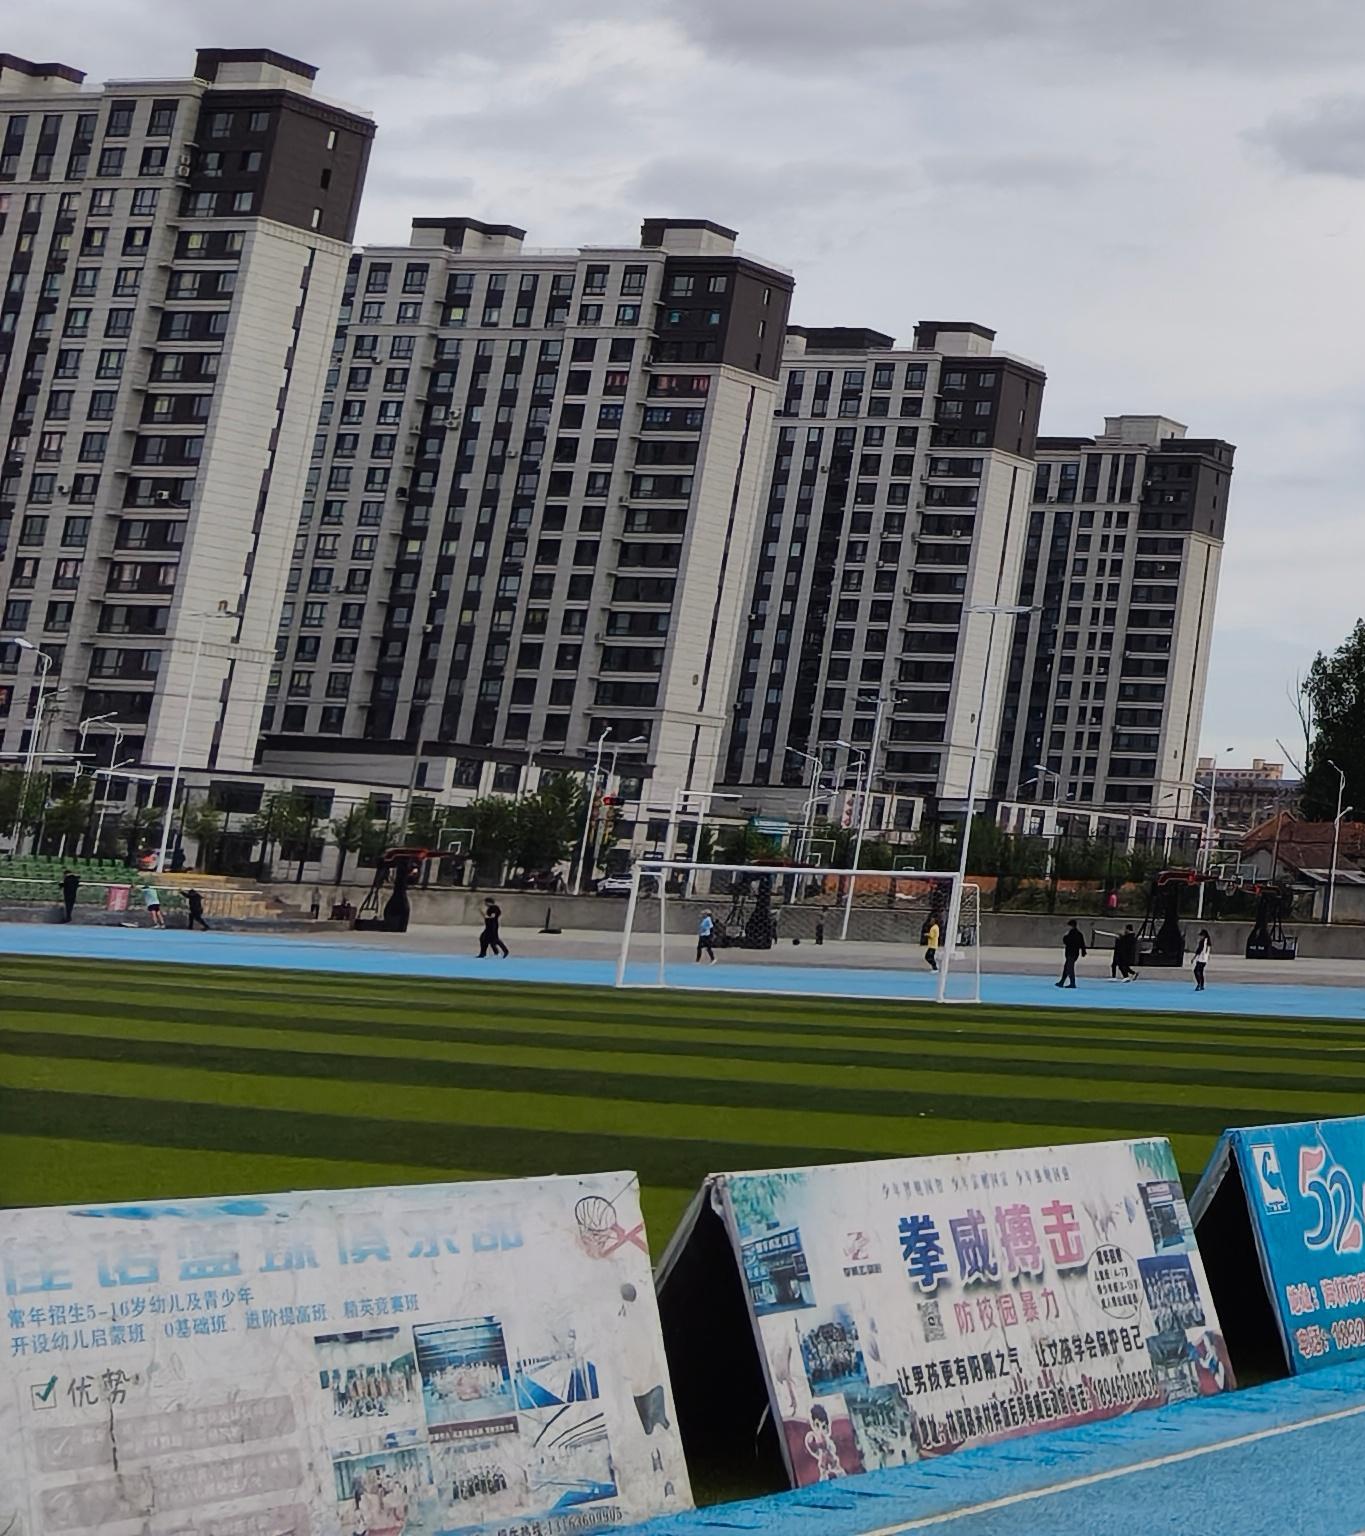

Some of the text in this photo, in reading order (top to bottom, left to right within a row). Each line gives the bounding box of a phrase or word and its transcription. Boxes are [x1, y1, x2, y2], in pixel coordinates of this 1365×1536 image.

[898, 1199, 1085, 1287] 拳威搏击
[955, 1286, 1061, 1336] 防校园暴力
[68, 1368, 129, 1407] 优势
[897, 1325, 1145, 1397] 让男孩更有阳刚之气 让女孩学会保护自己
